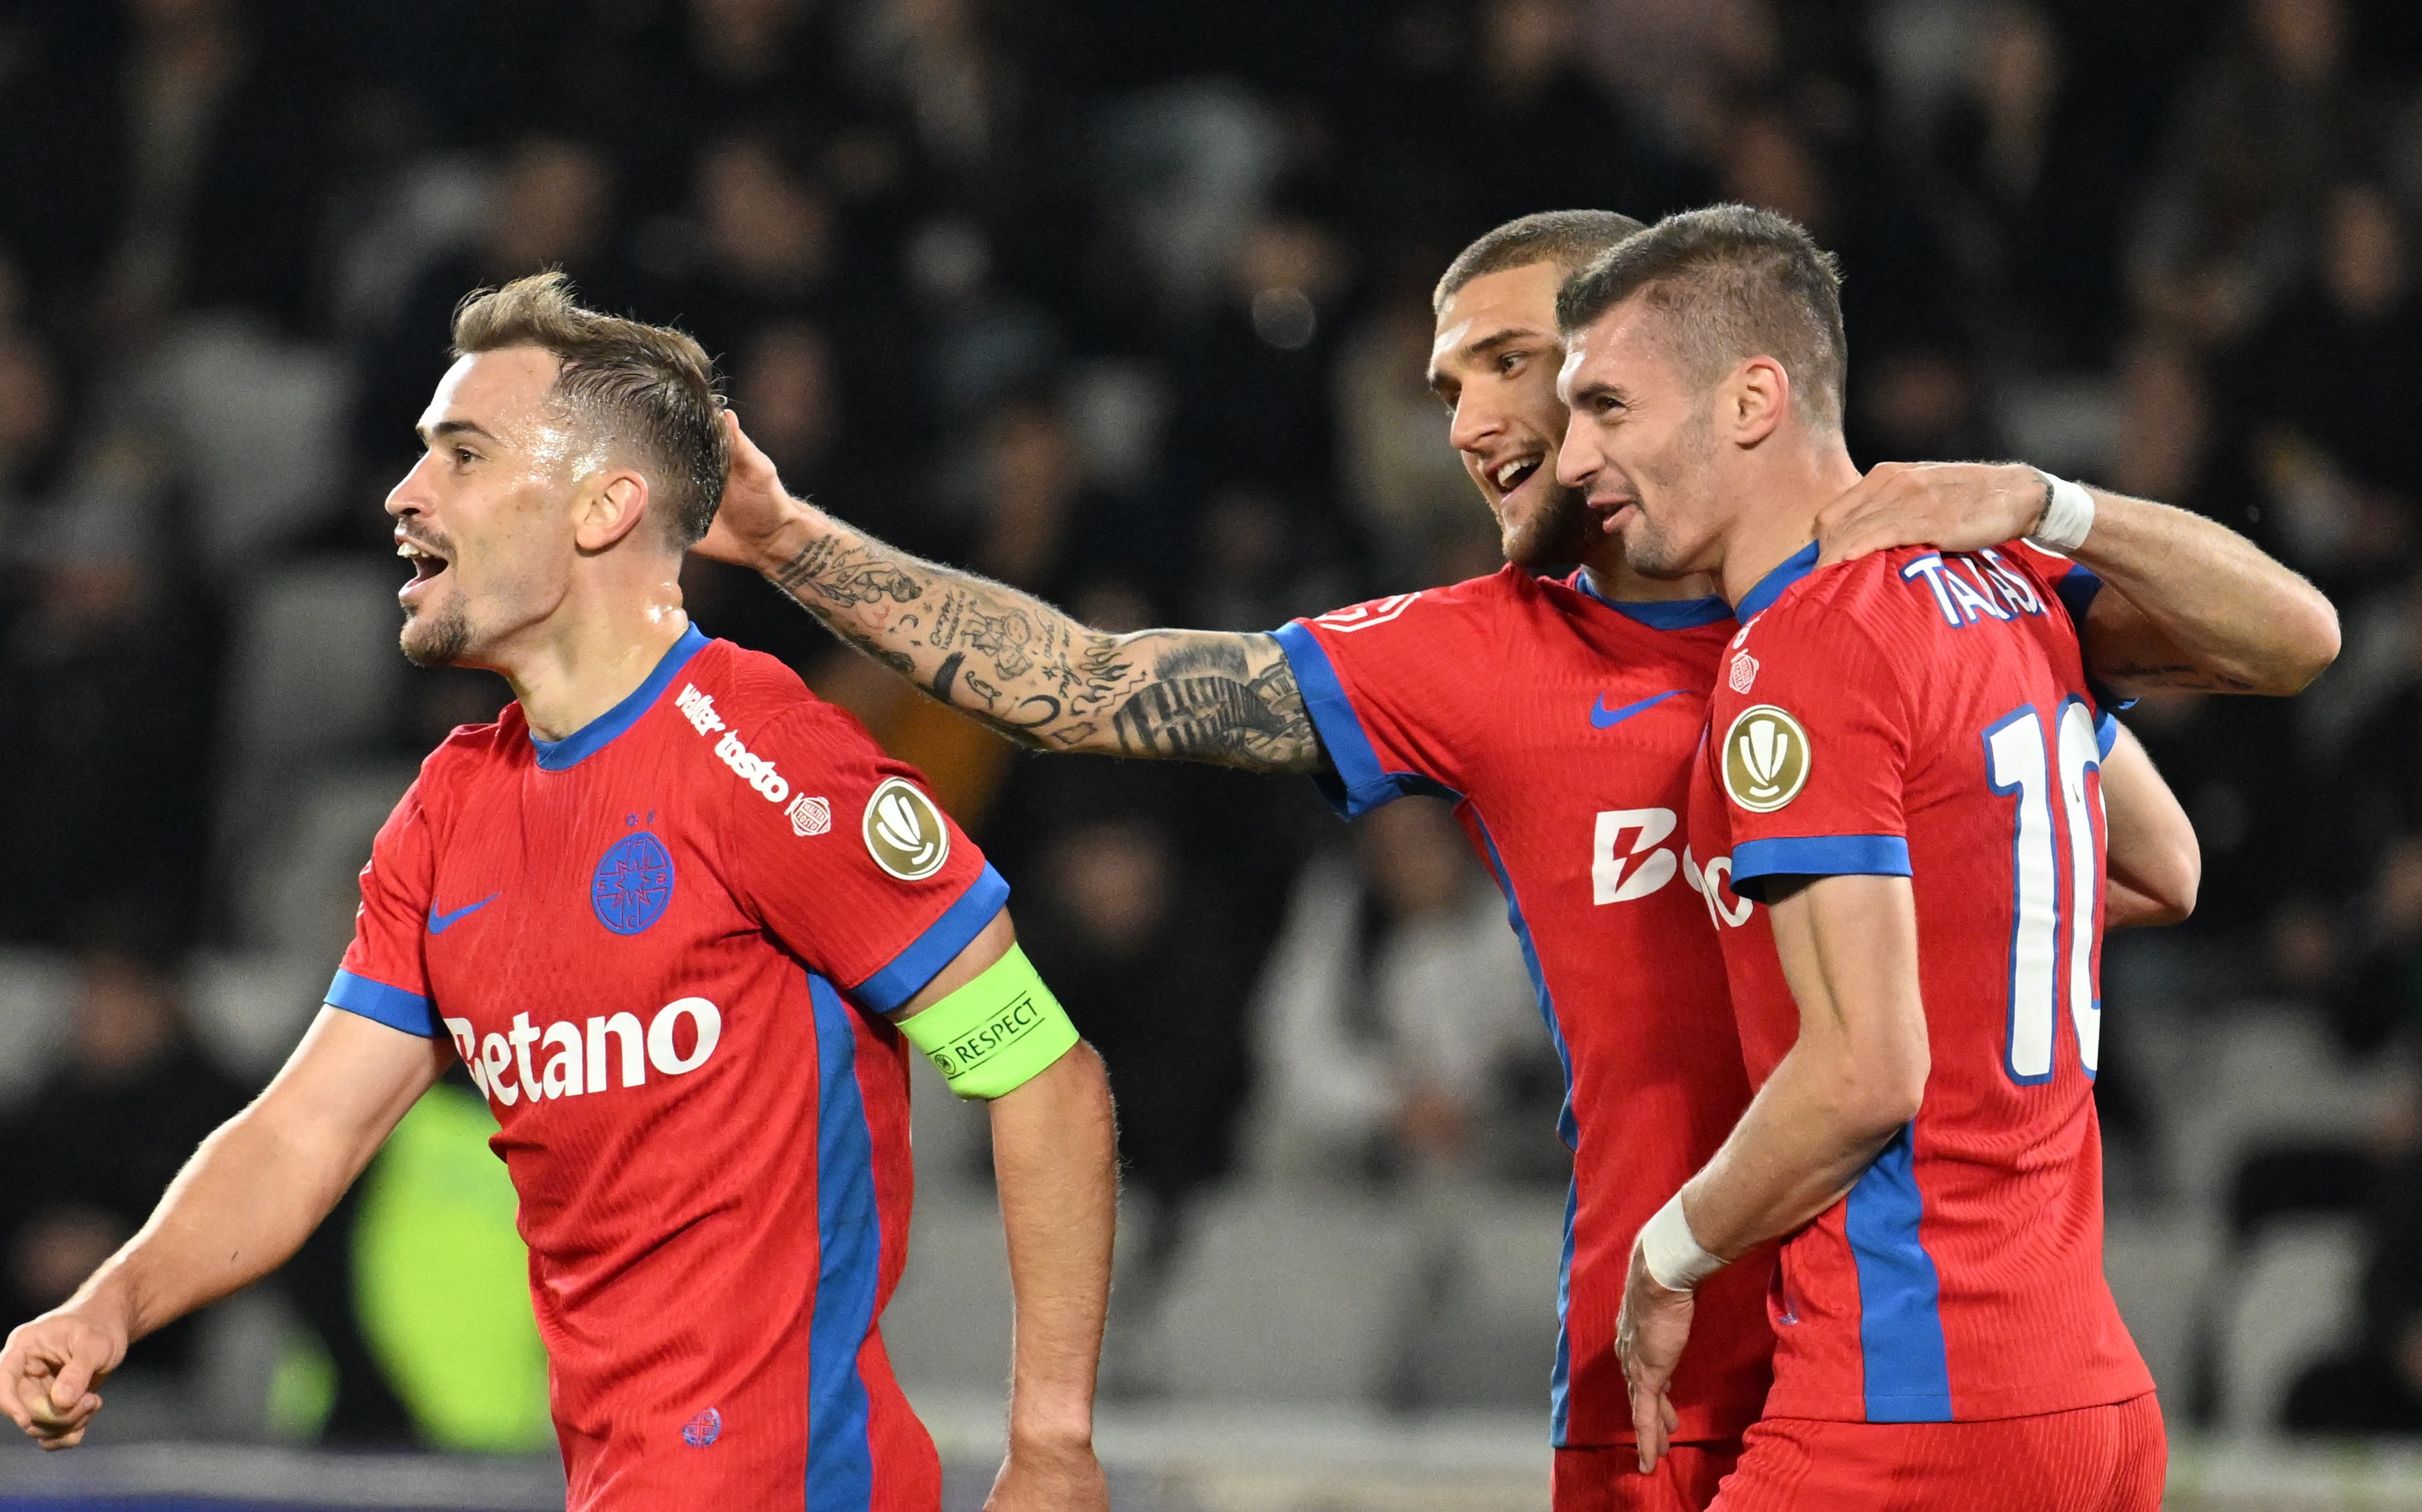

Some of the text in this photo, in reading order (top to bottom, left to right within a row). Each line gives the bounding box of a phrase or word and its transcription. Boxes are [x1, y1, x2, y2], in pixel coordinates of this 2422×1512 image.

[715, 730, 789, 802] tosto
[795, 810, 819, 831] TOSTO
[803, 802, 826, 822] WALTER
[1981, 692, 2108, 1086] 10
[443, 997, 721, 1106] Betano
[955, 997, 1037, 1063] RESPECT
